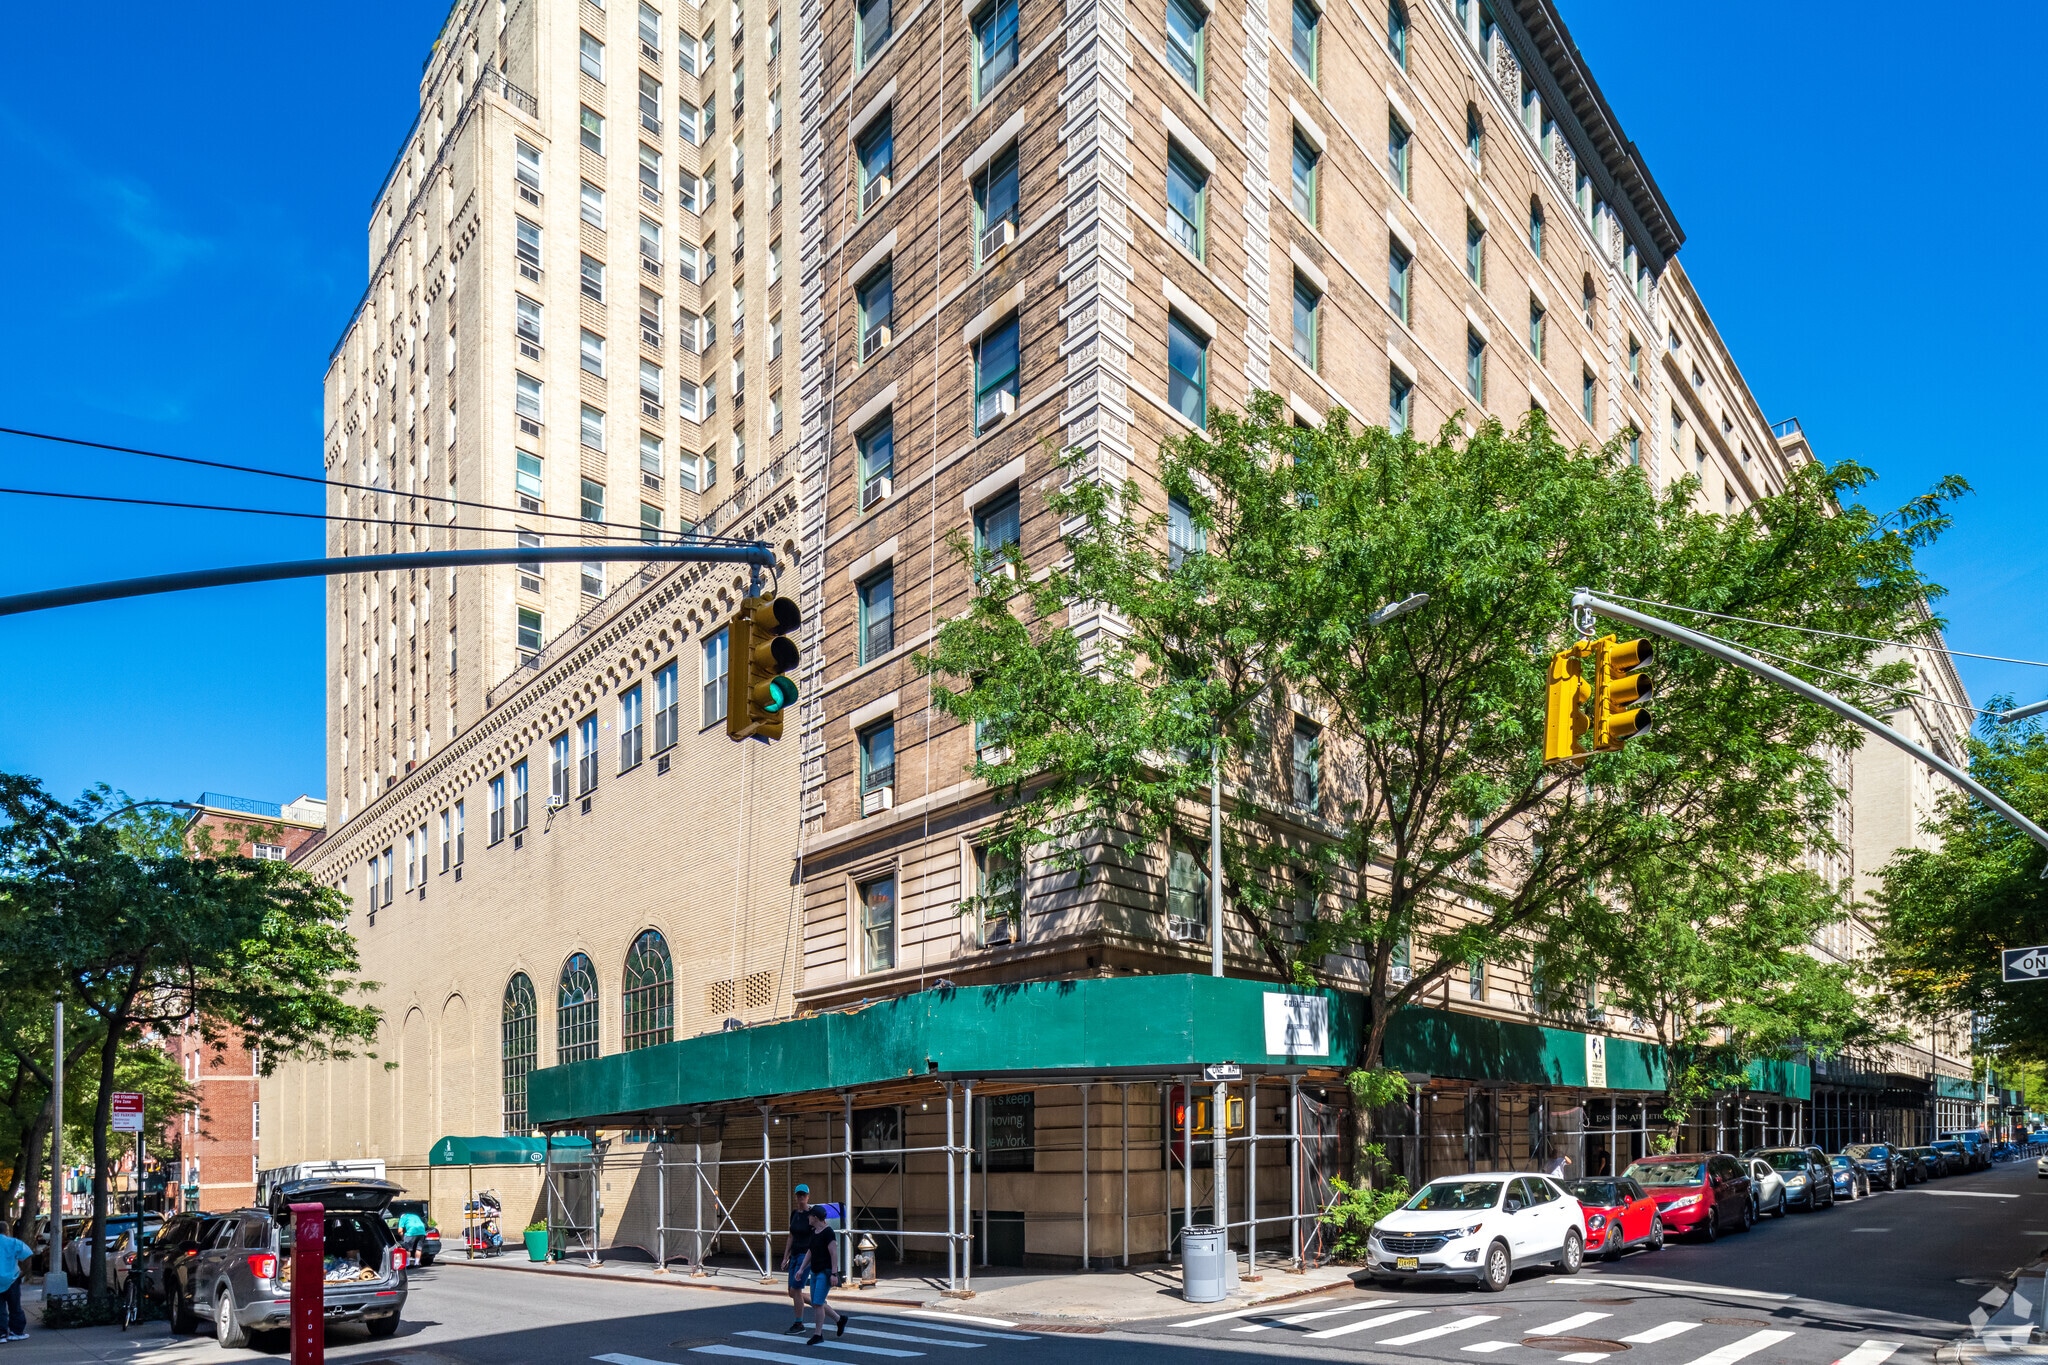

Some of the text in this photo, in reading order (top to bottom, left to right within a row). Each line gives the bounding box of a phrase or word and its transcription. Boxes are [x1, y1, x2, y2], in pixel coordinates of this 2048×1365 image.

[1006, 1094, 1031, 1108] keep
[1596, 1114, 1628, 1122] EASRN
[1005, 1133, 1030, 1147] York.
